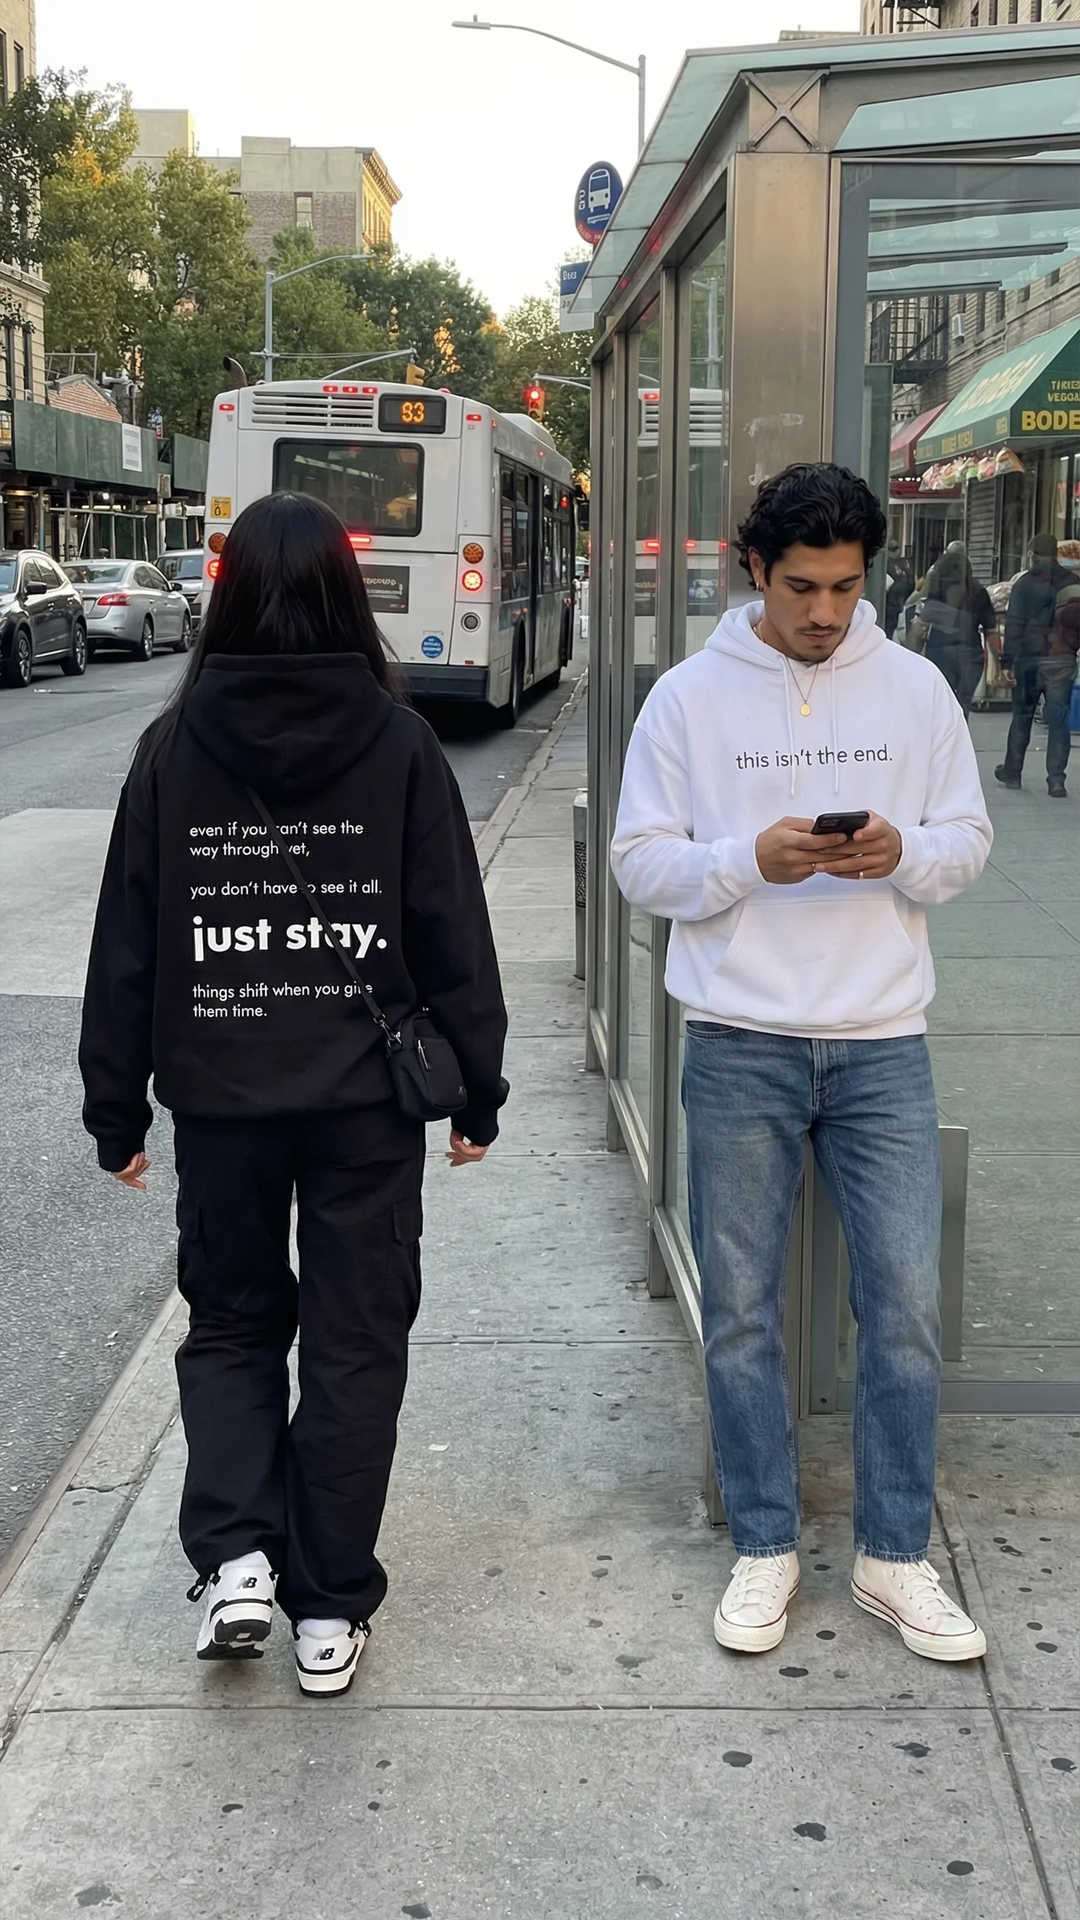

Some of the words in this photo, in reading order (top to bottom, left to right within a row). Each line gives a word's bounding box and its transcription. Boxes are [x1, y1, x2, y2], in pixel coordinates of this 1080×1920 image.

[1022, 410, 1080, 431] BODE
[736, 751, 770, 769] this
[775, 749, 812, 767] isn't
[816, 746, 848, 765] the
[853, 743, 893, 762] end.
[189, 826, 223, 837] even
[227, 821, 238, 836] if
[241, 825, 268, 839] you
[275, 821, 308, 835] an't
[312, 824, 337, 835] see
[340, 820, 364, 835] the
[189, 846, 219, 859] way
[222, 840, 279, 859] through
[190, 886, 216, 900] you
[221, 881, 259, 896] don't
[263, 881, 298, 895] have
[320, 883, 345, 894] see
[349, 879, 358, 893] it
[361, 879, 382, 894] all.
[193, 915, 272, 962] just
[286, 917, 387, 959] stay.
[193, 983, 235, 1001] things
[239, 982, 269, 998] shift
[272, 981, 310, 997] when
[314, 985, 340, 999] you
[193, 1004, 228, 1018] them
[232, 1003, 268, 1018] time.
[236, 1576, 258, 1590] NB
[312, 1647, 335, 1661] NB
